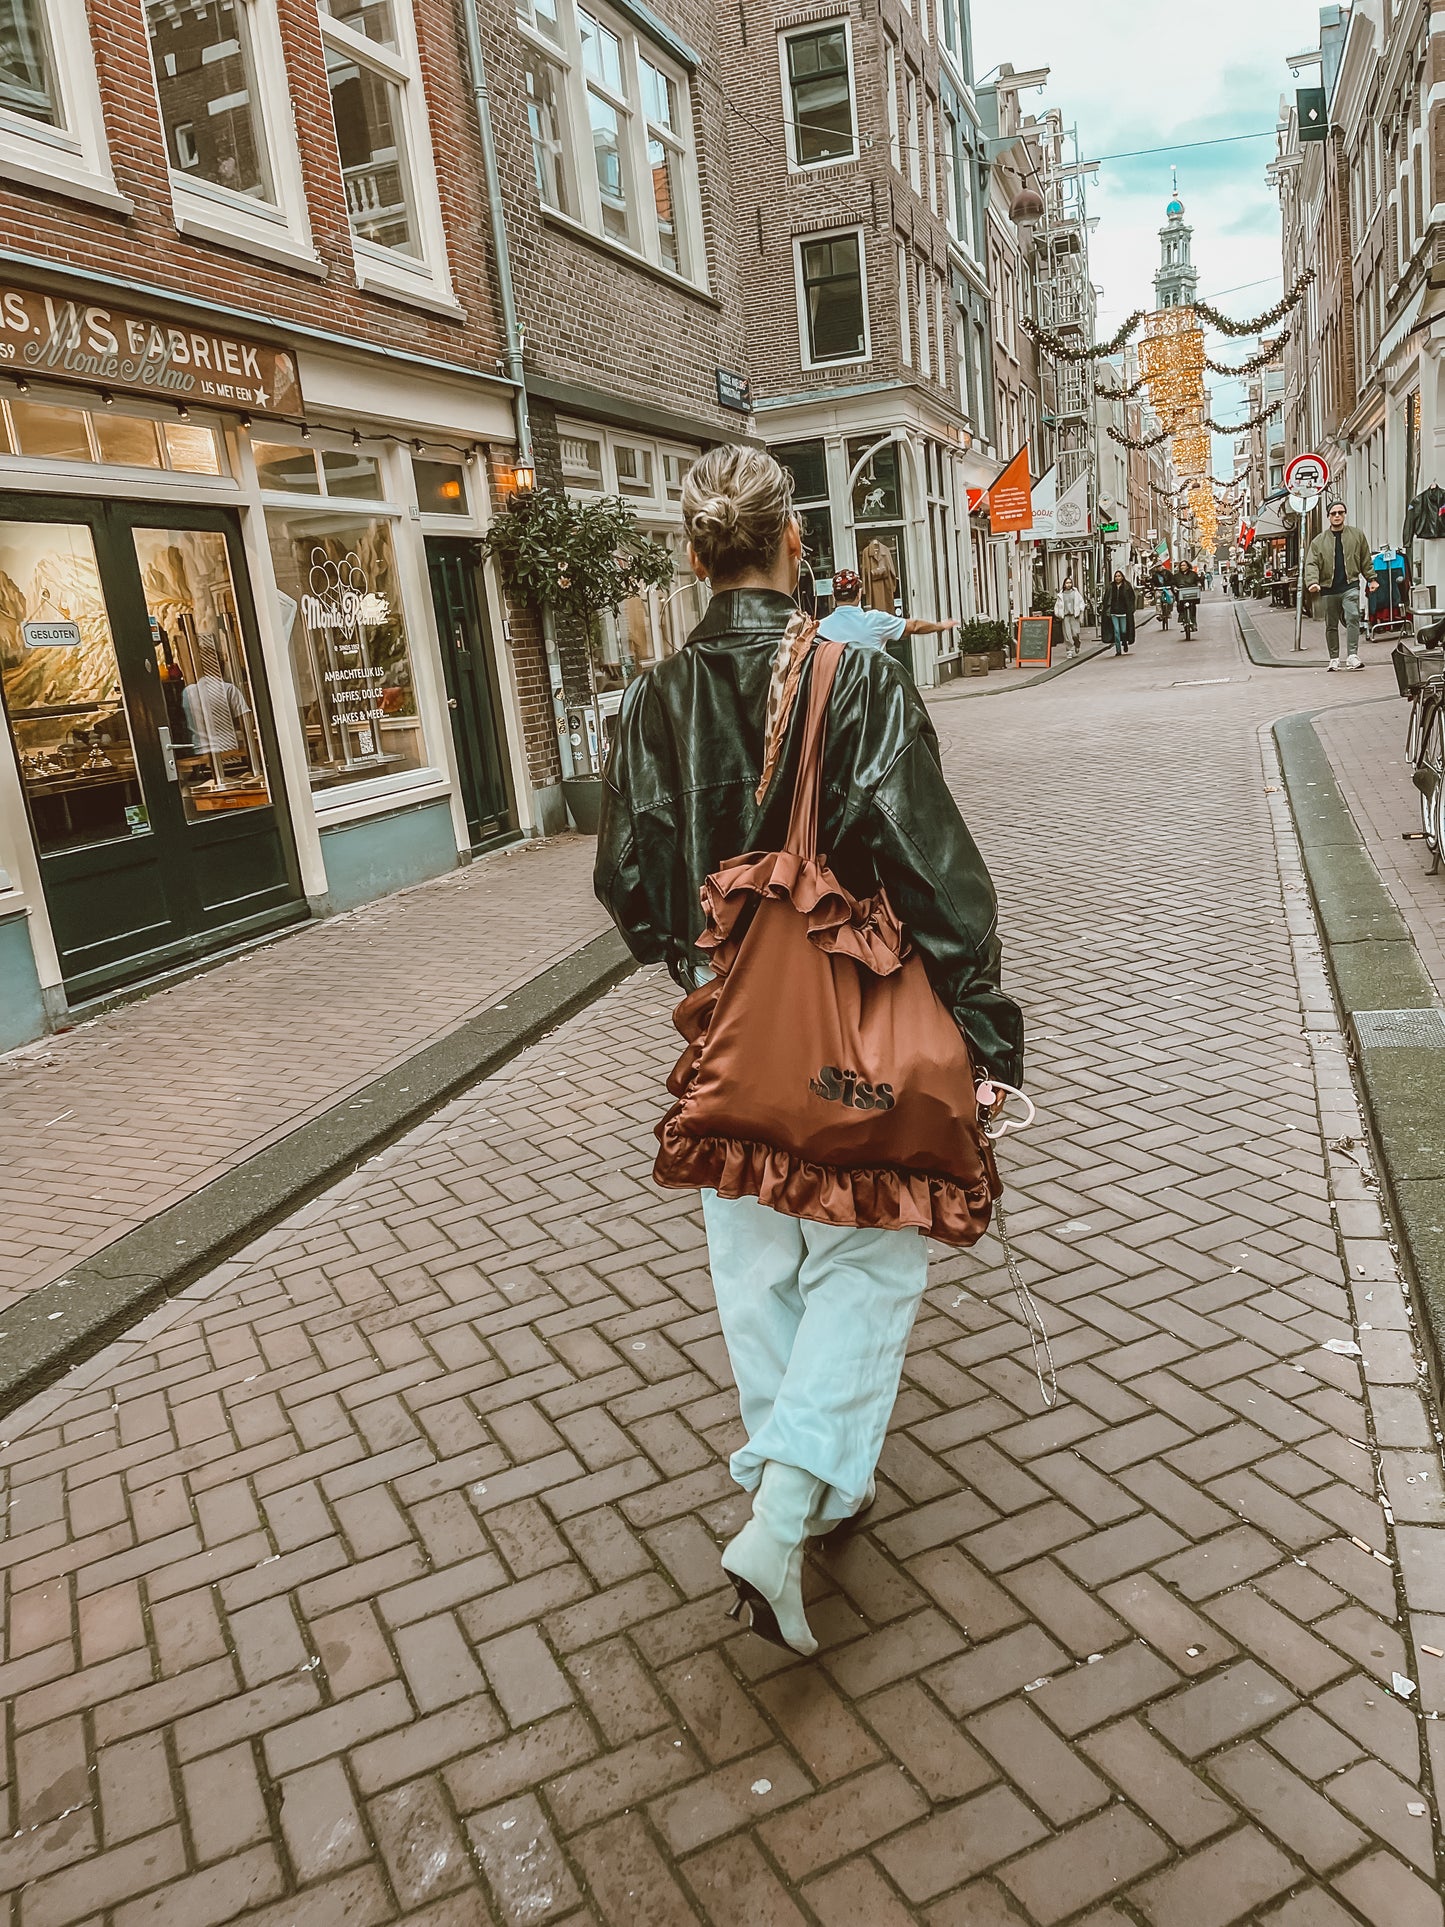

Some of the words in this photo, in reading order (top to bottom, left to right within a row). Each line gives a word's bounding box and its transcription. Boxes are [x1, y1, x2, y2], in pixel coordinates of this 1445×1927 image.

[0, 293, 40, 335] S.
[125, 319, 263, 380] FABRIEK
[24, 303, 118, 378] Monte
[120, 319, 195, 392] Pelmo
[216, 383, 234, 398] MET
[235, 386, 253, 401] EEN
[301, 594, 343, 630] Monte
[30, 630, 75, 640] GESLOTEN
[361, 687, 384, 699] DOLCE
[332, 711, 359, 725] SHAKES
[359, 710, 366, 721] &
